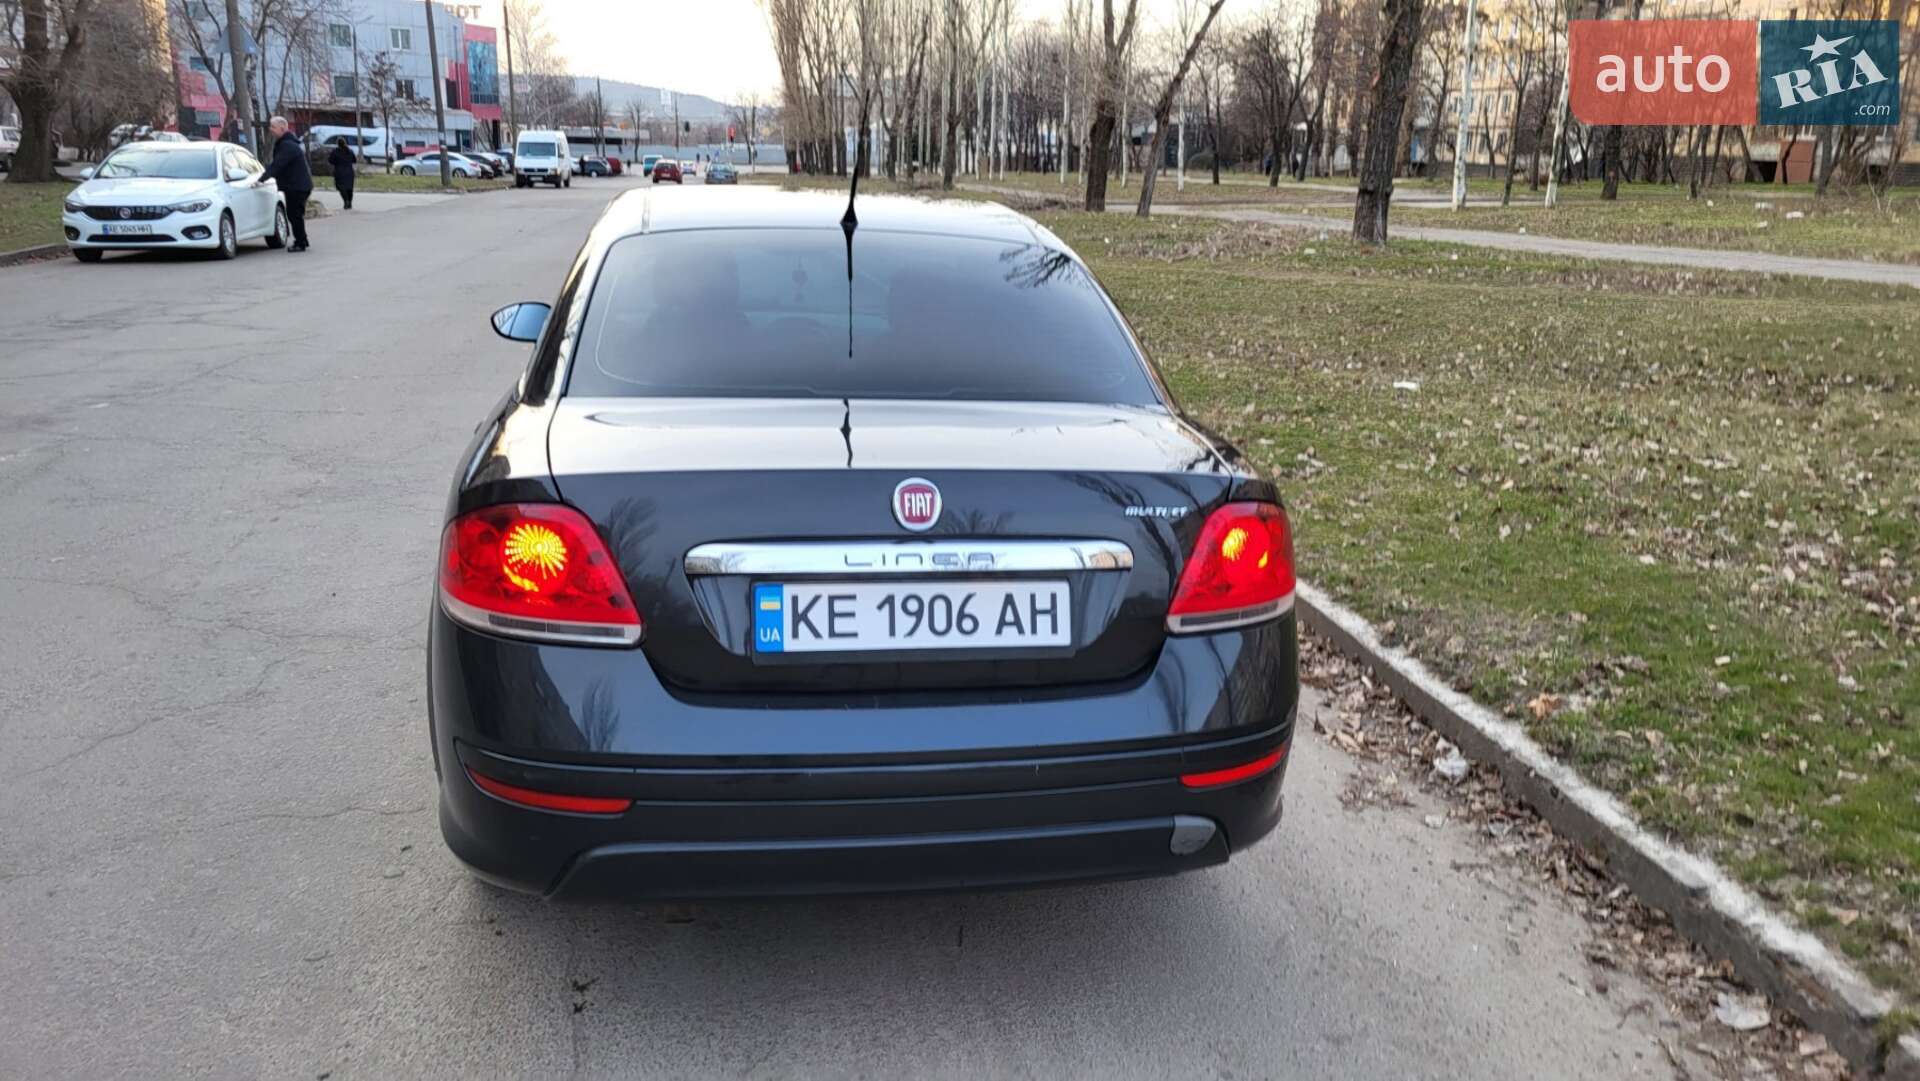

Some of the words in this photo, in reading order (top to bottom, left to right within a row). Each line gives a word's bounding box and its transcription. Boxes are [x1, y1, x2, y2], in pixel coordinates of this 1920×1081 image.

[903, 492, 933, 518] FIAT
[844, 552, 996, 568] LINEA
[790, 593, 859, 640] KE
[876, 592, 980, 638] 1906
[994, 591, 1060, 636] AH
[760, 627, 781, 643] UA
